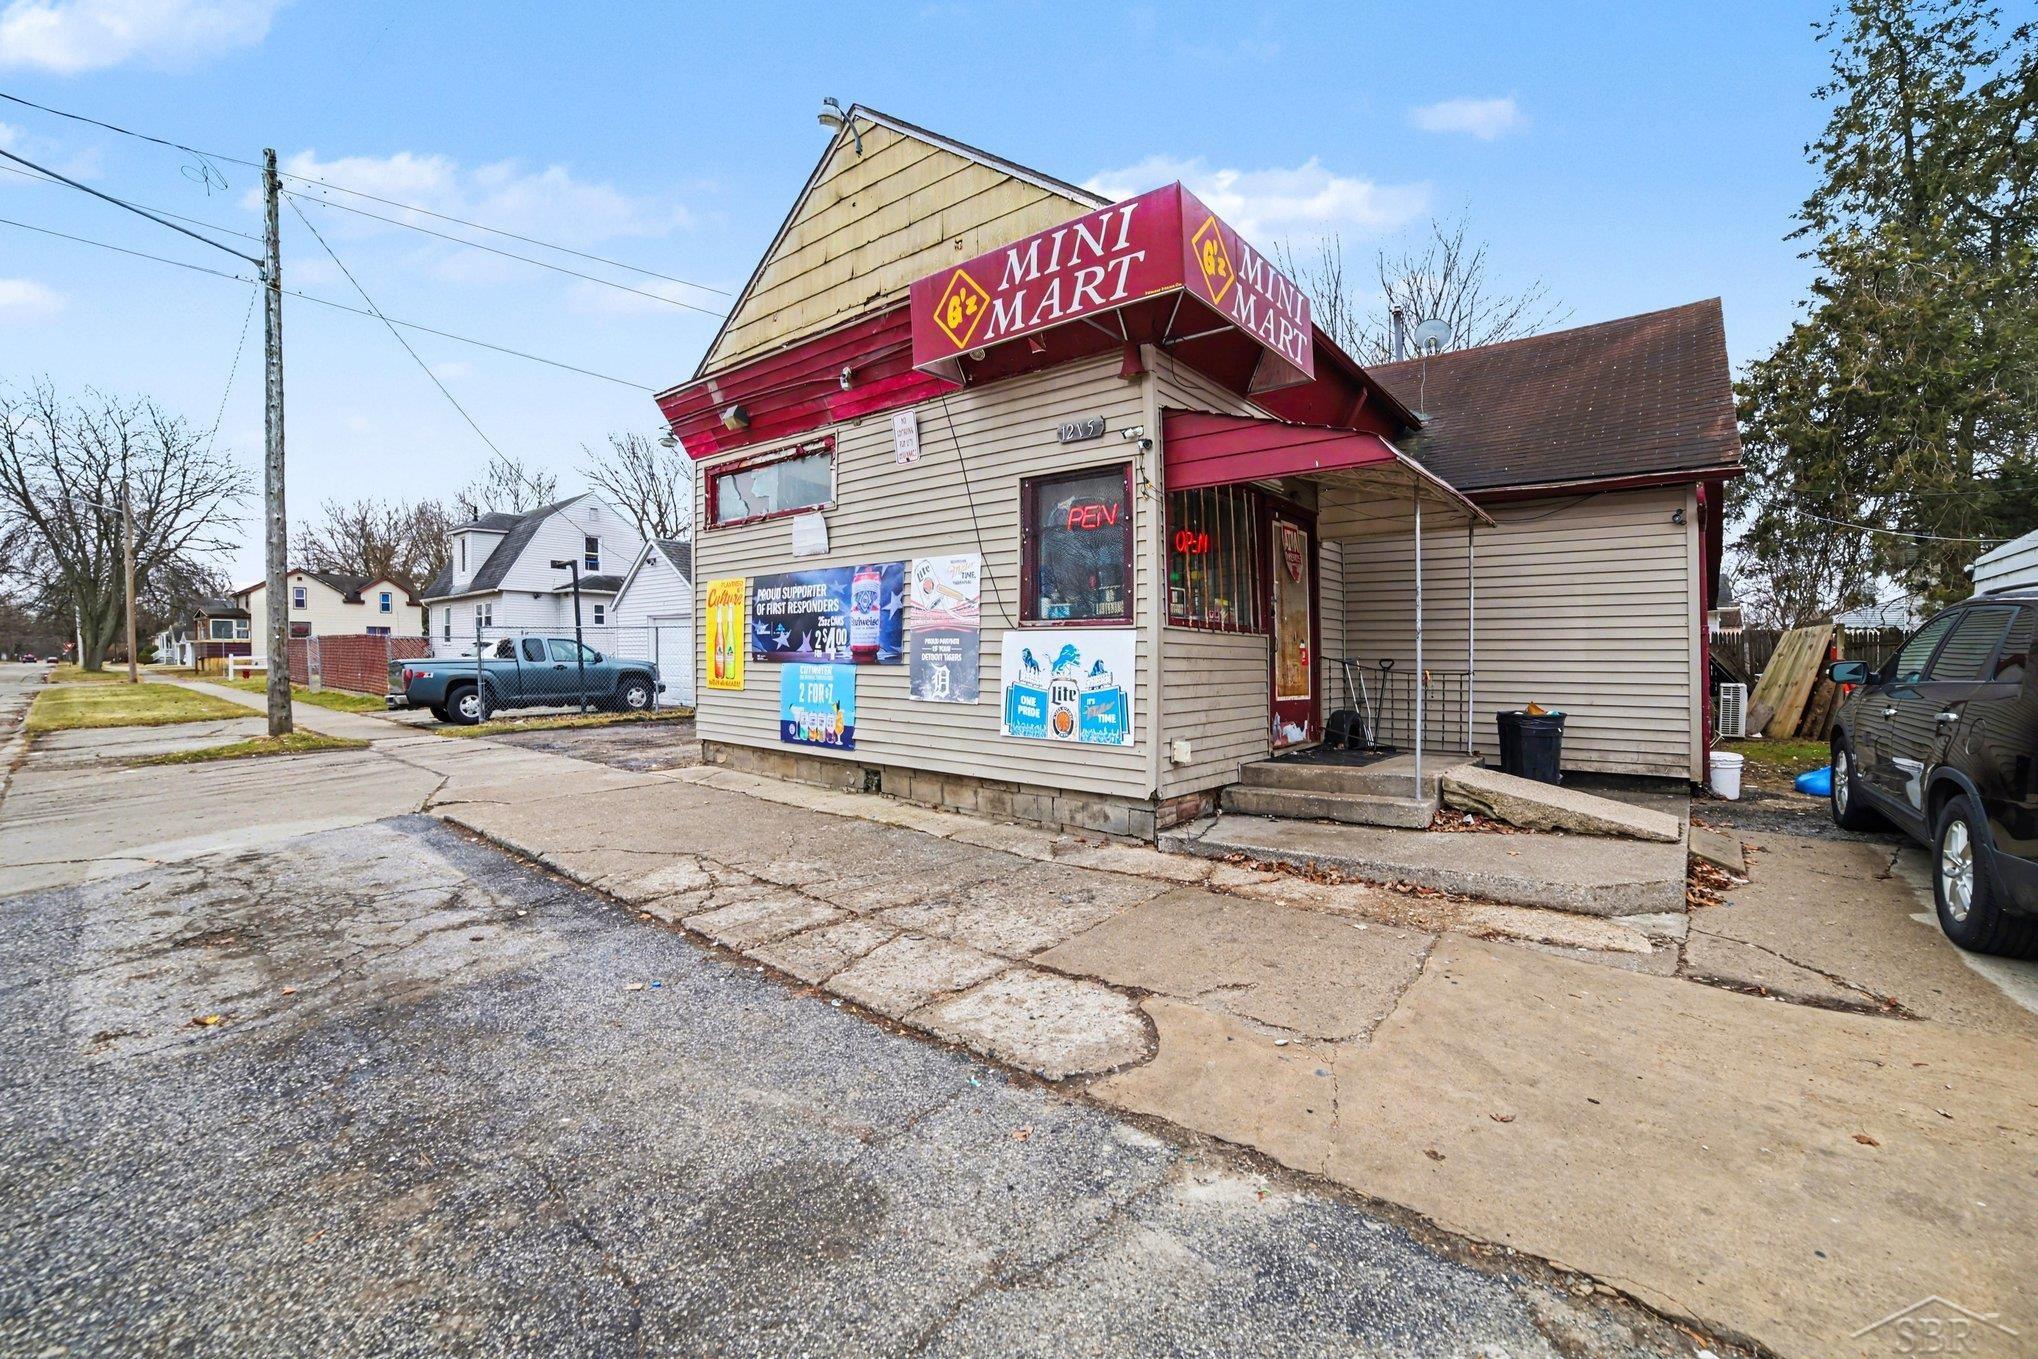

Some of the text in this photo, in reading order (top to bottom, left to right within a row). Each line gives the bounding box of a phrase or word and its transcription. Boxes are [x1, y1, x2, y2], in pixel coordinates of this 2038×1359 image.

[997, 203, 1138, 291] MINI
[1238, 244, 1304, 326] MINI
[983, 250, 1146, 340] MART
[1231, 281, 1308, 365] MART
[757, 584, 827, 601] PROUD SUPPORTER
[756, 598, 840, 616] OF FIRST RESPONDERS
[815, 630, 822, 649] 2
[921, 653, 962, 661] DETROIT TIGERS
[799, 683, 805, 703] 2
[807, 683, 825, 703] FOR
[1020, 695, 1037, 707] ONE
[1051, 685, 1077, 705] Lite
[1017, 705, 1041, 719] PRIDE
[1098, 713, 1117, 724] TIME
